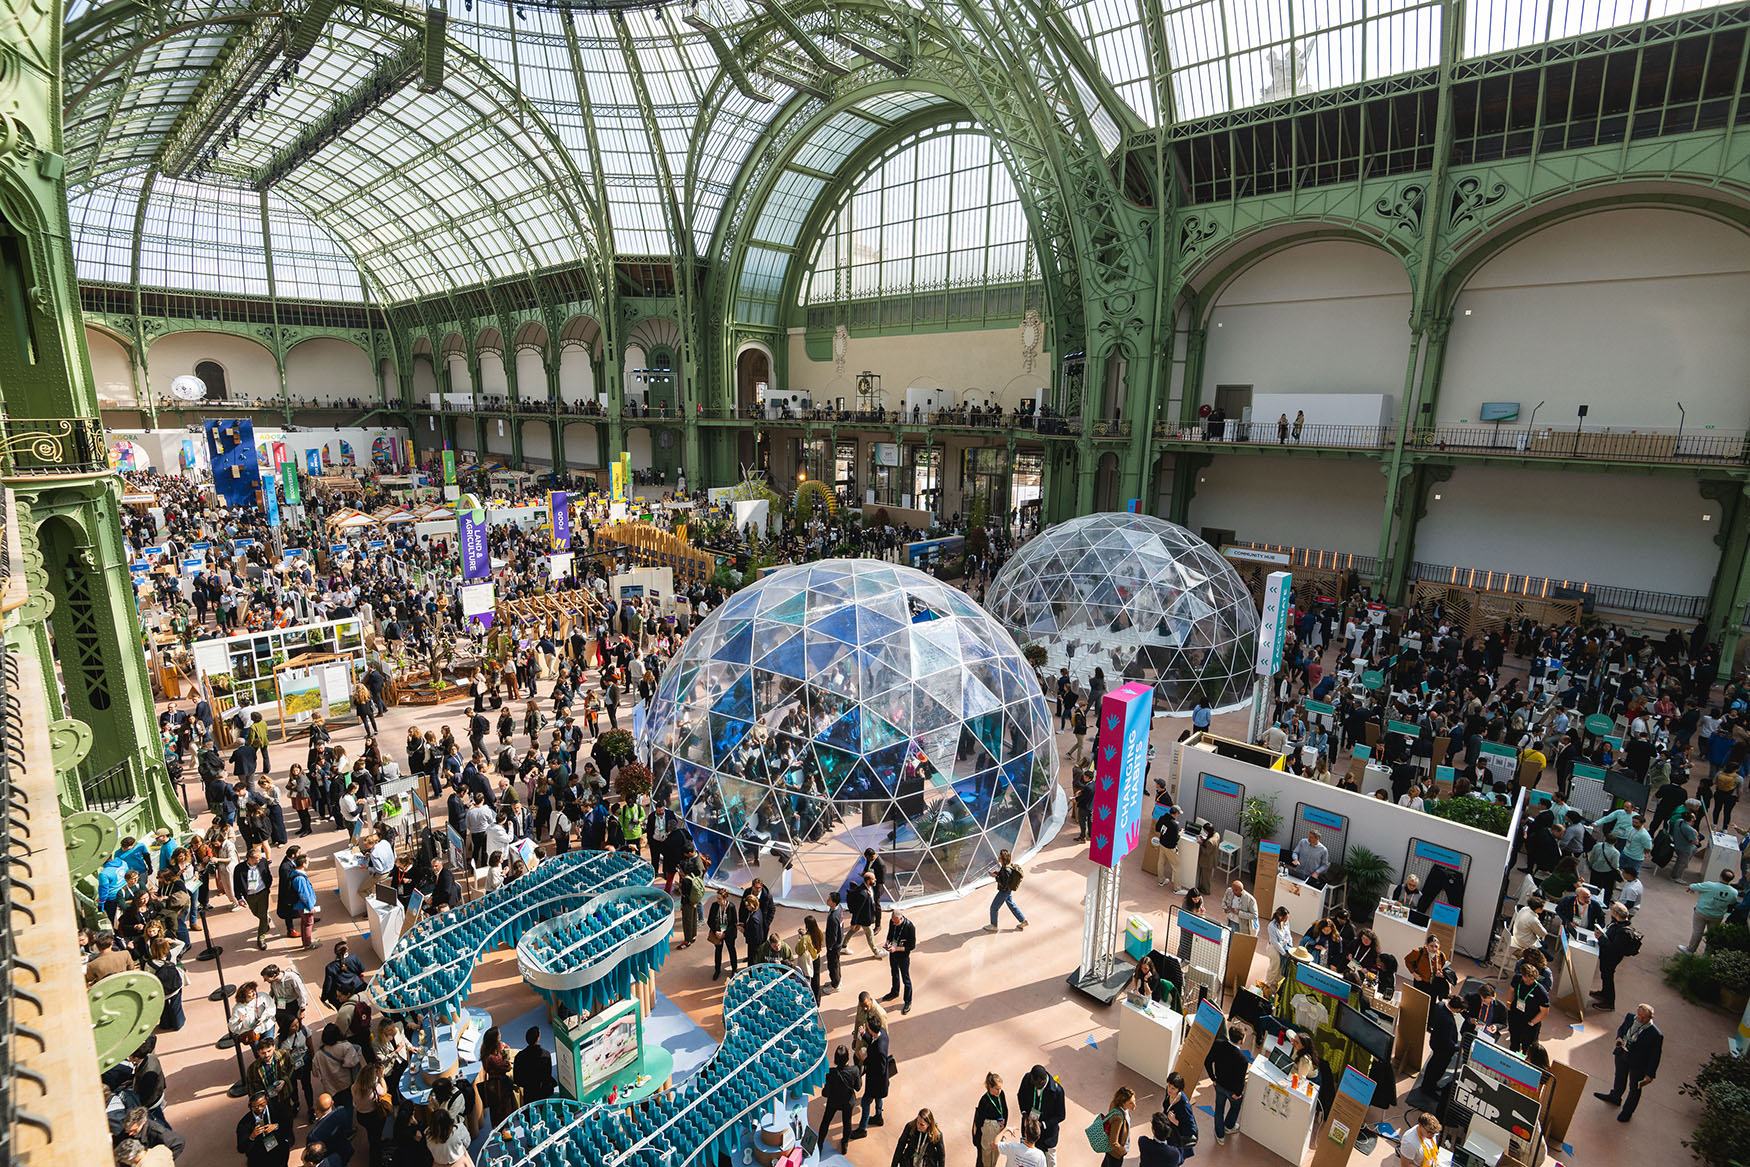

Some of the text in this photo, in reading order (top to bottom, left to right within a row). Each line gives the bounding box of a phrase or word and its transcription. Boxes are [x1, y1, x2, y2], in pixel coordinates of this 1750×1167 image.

[286, 466, 296, 499] BIODIVERSITY
[465, 518, 477, 572] AGRICULTURE
[474, 529, 482, 552] LAND
[1233, 550, 1263, 559] COMMUNITY
[1275, 588, 1287, 658] ACCELERATE
[1120, 729, 1136, 829] CHANGING
[1130, 740, 1143, 807] HABITS
